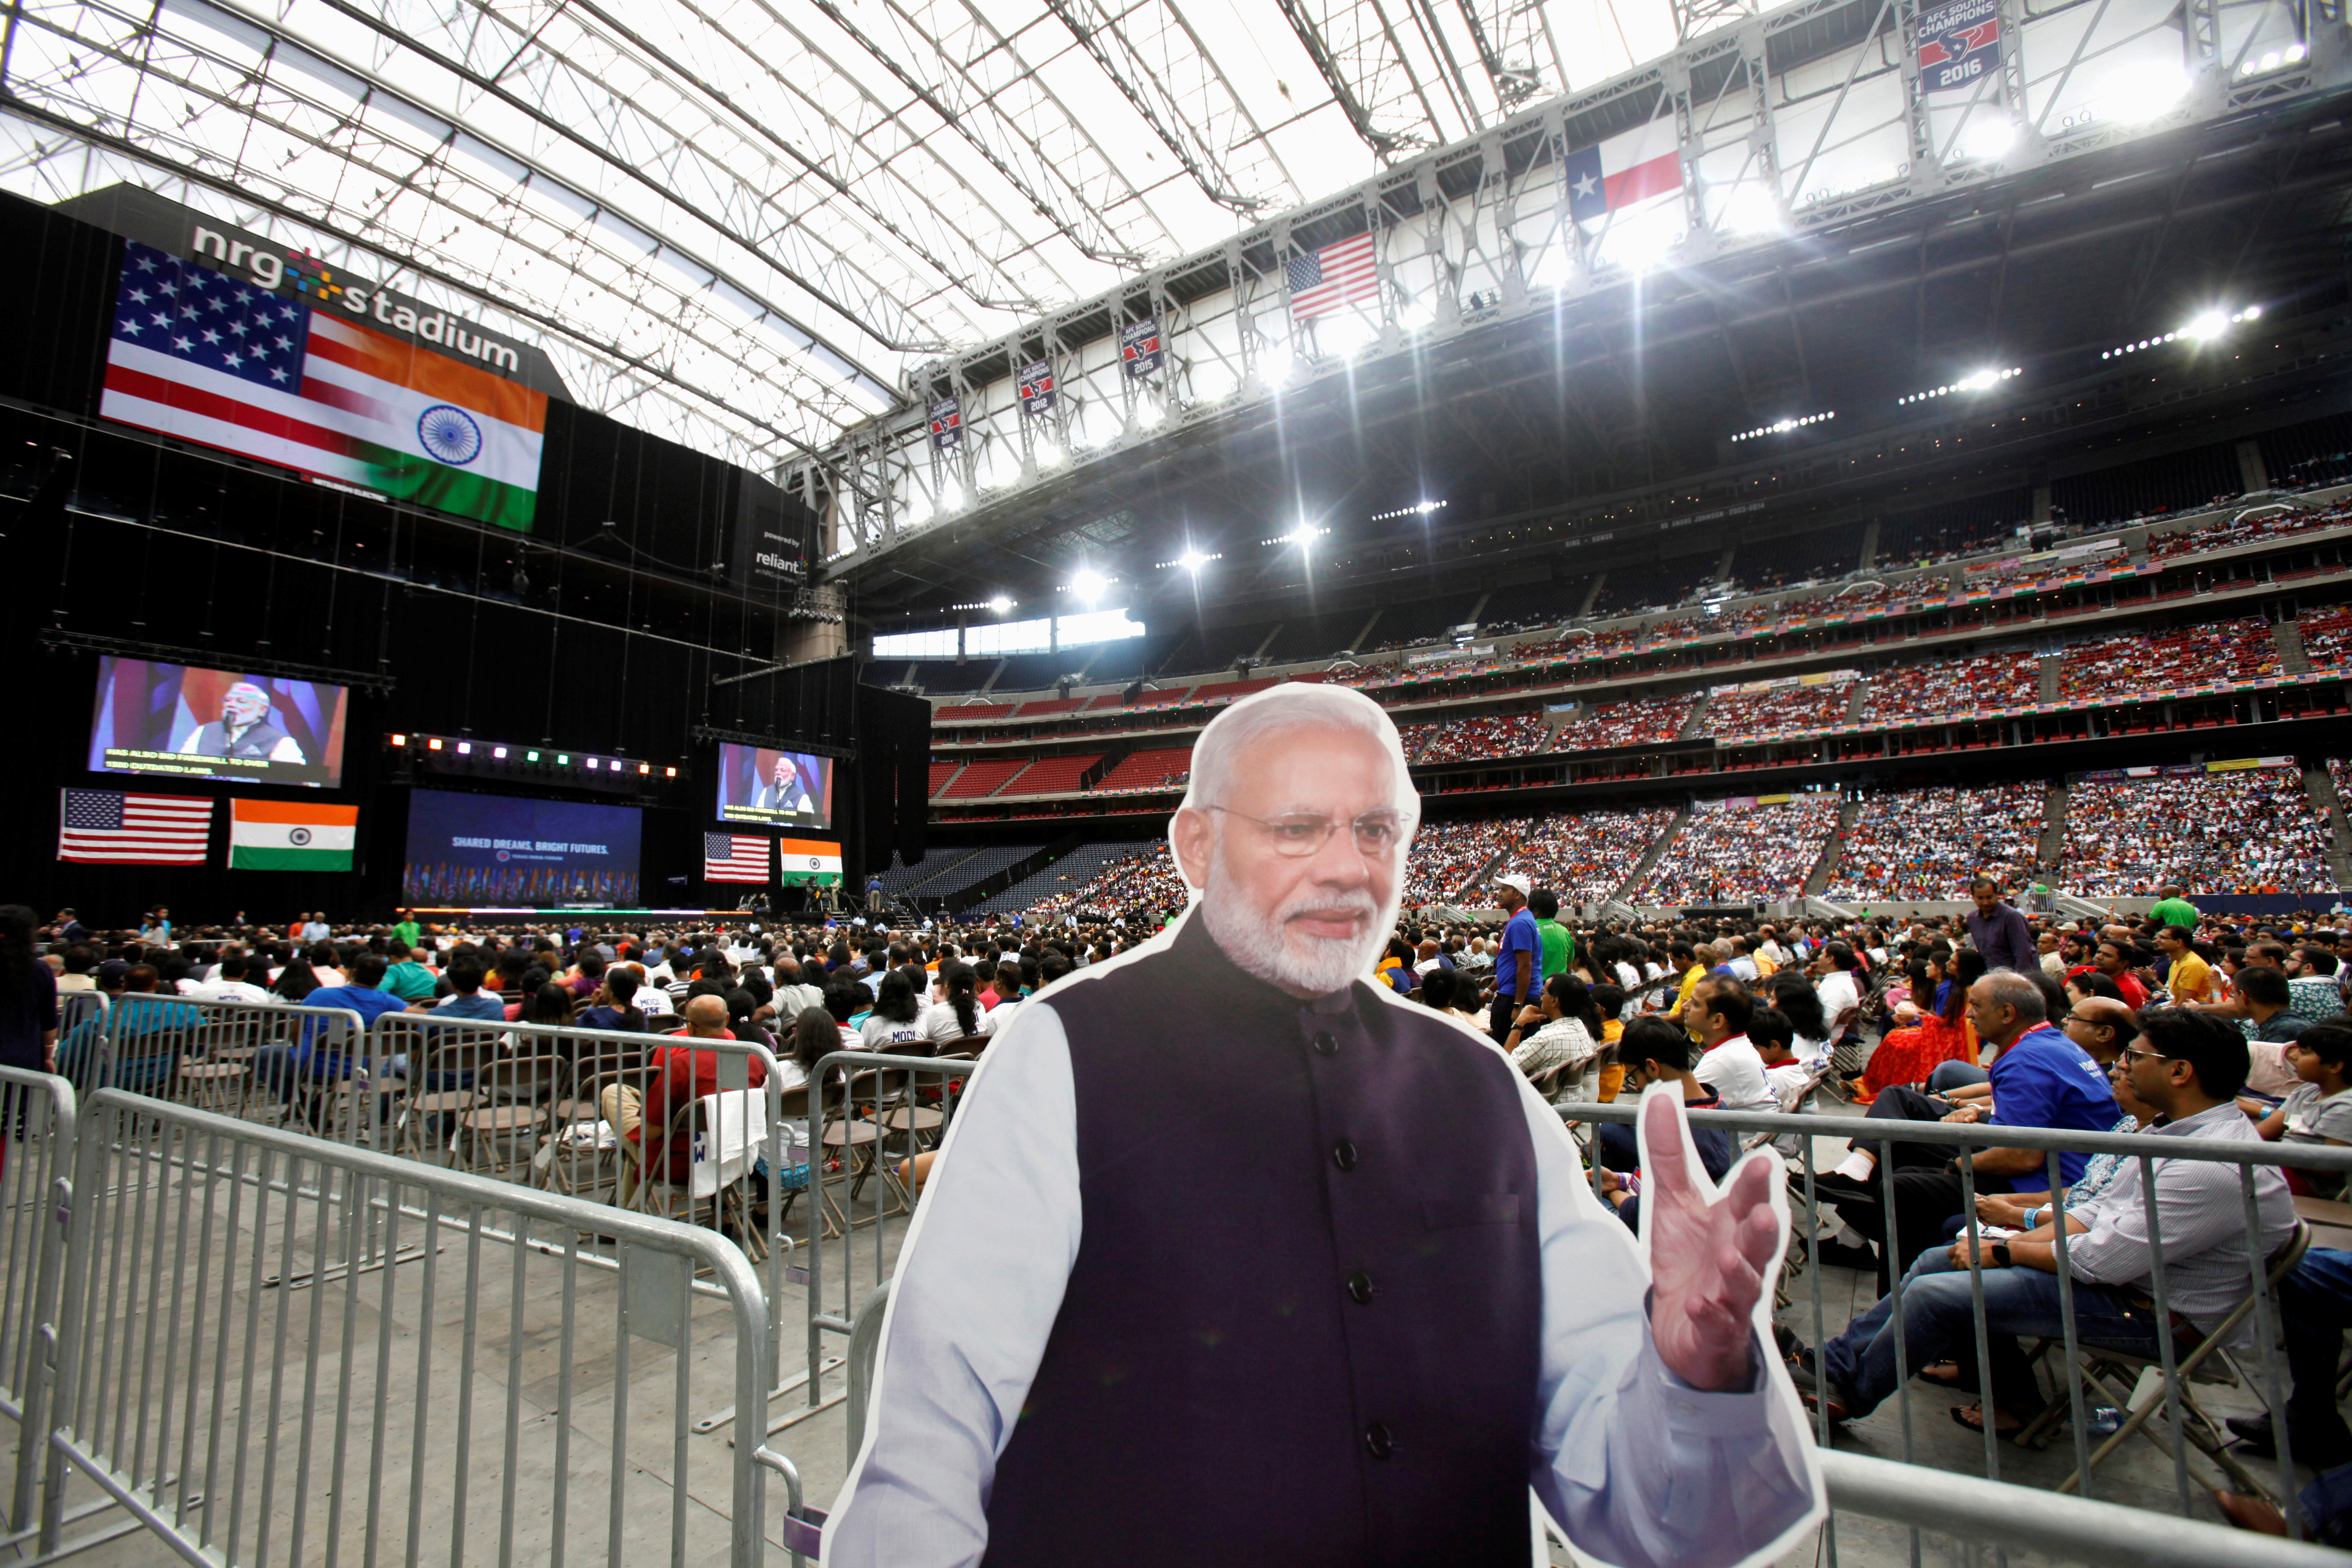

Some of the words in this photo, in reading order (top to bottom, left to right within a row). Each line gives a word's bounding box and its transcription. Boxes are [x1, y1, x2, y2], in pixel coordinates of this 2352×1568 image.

[1918, 1, 1994, 38] CHAMPIONS
[1926, 10, 1947, 25] AFC
[1949, 0, 1985, 15] SOUTH
[1940, 58, 1982, 87] 2016
[192, 225, 284, 289] nrg
[342, 285, 518, 372] stadium
[1135, 320, 1151, 330] SOUTH
[1122, 324, 1155, 342] CHAMPIONS
[1032, 362, 1045, 371] SOUTH
[1134, 358, 1153, 374] 2015
[1020, 366, 1049, 382] CHAMPIONS
[931, 403, 957, 418] CHAMPIONS
[941, 399, 953, 408] SOUTH
[1031, 397, 1048, 411] 2012
[941, 433, 954, 445] 2011
[1694, 511, 1725, 522] JOHNSON
[764, 531, 791, 544] powered
[792, 538, 799, 547] by
[756, 552, 798, 573] reliant
[762, 570, 774, 578] NRG
[774, 574, 796, 585] company
[106, 748, 129, 756] HAS
[129, 750, 158, 758] ALSO
[177, 754, 228, 765] FAREWELL
[243, 759, 269, 768] OVER
[129, 762, 183, 773] OUTDATED
[183, 766, 215, 775] LAWS.
[2163, 766, 2202, 775] ONENESS
[452, 837, 492, 848] SHARED
[493, 839, 534, 851] DREAMS,
[535, 841, 569, 852] BRIGHT
[570, 843, 609, 854] FUTURES.
[640, 998, 660, 1007] MODI
[892, 1031, 916, 1043] MODI
